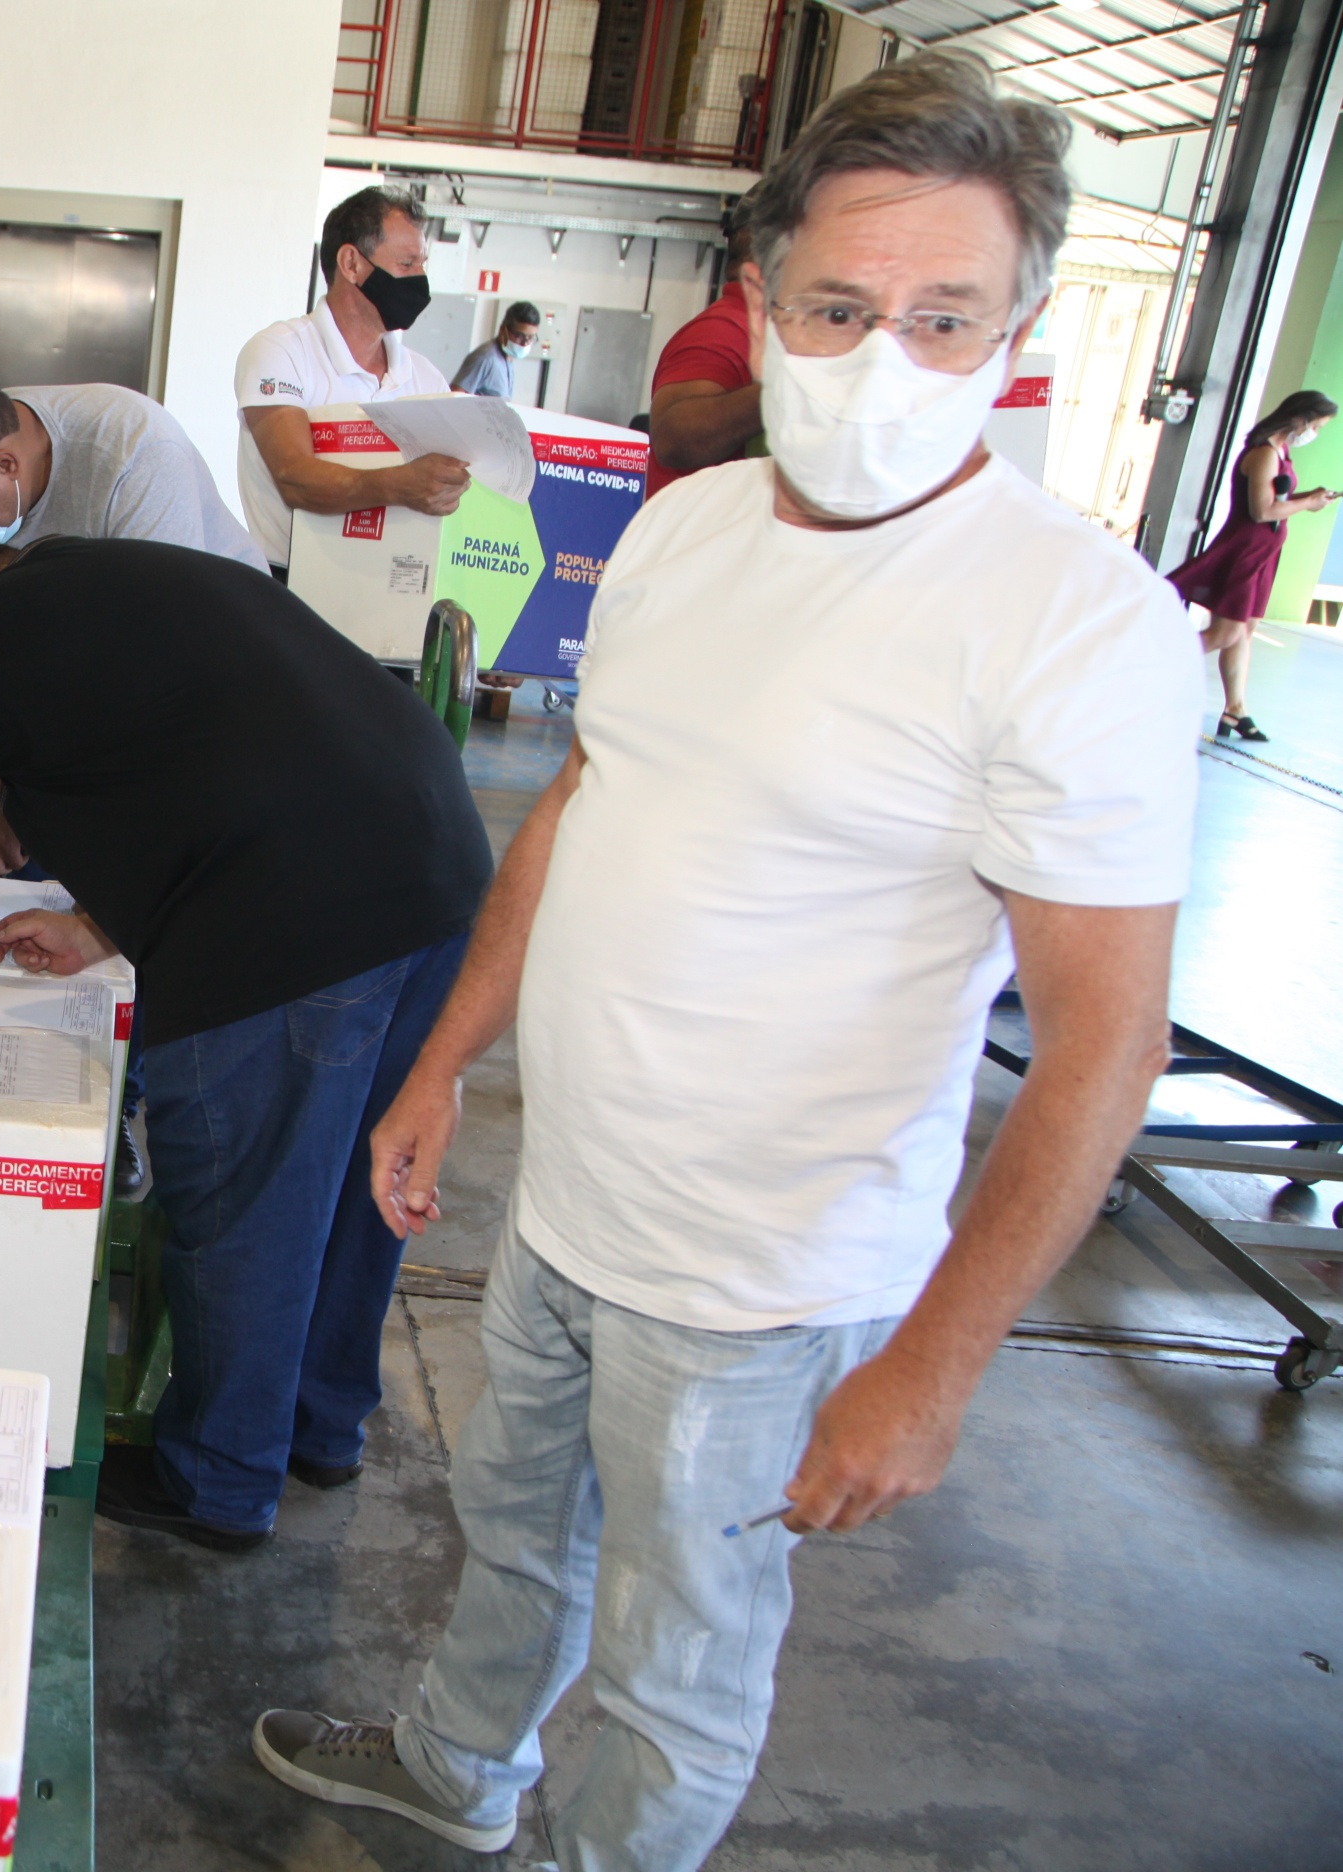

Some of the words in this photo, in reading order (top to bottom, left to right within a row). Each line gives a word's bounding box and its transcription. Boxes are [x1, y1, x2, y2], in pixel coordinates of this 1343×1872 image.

[344, 434, 385, 445] PERECÍVEL
[551, 444, 597, 461] ATENÇÃO:
[539, 461, 584, 482] VACINA
[588, 471, 640, 492] COVID-19
[464, 537, 520, 558] PARANÁ
[452, 552, 529, 576] IMUNIZADO
